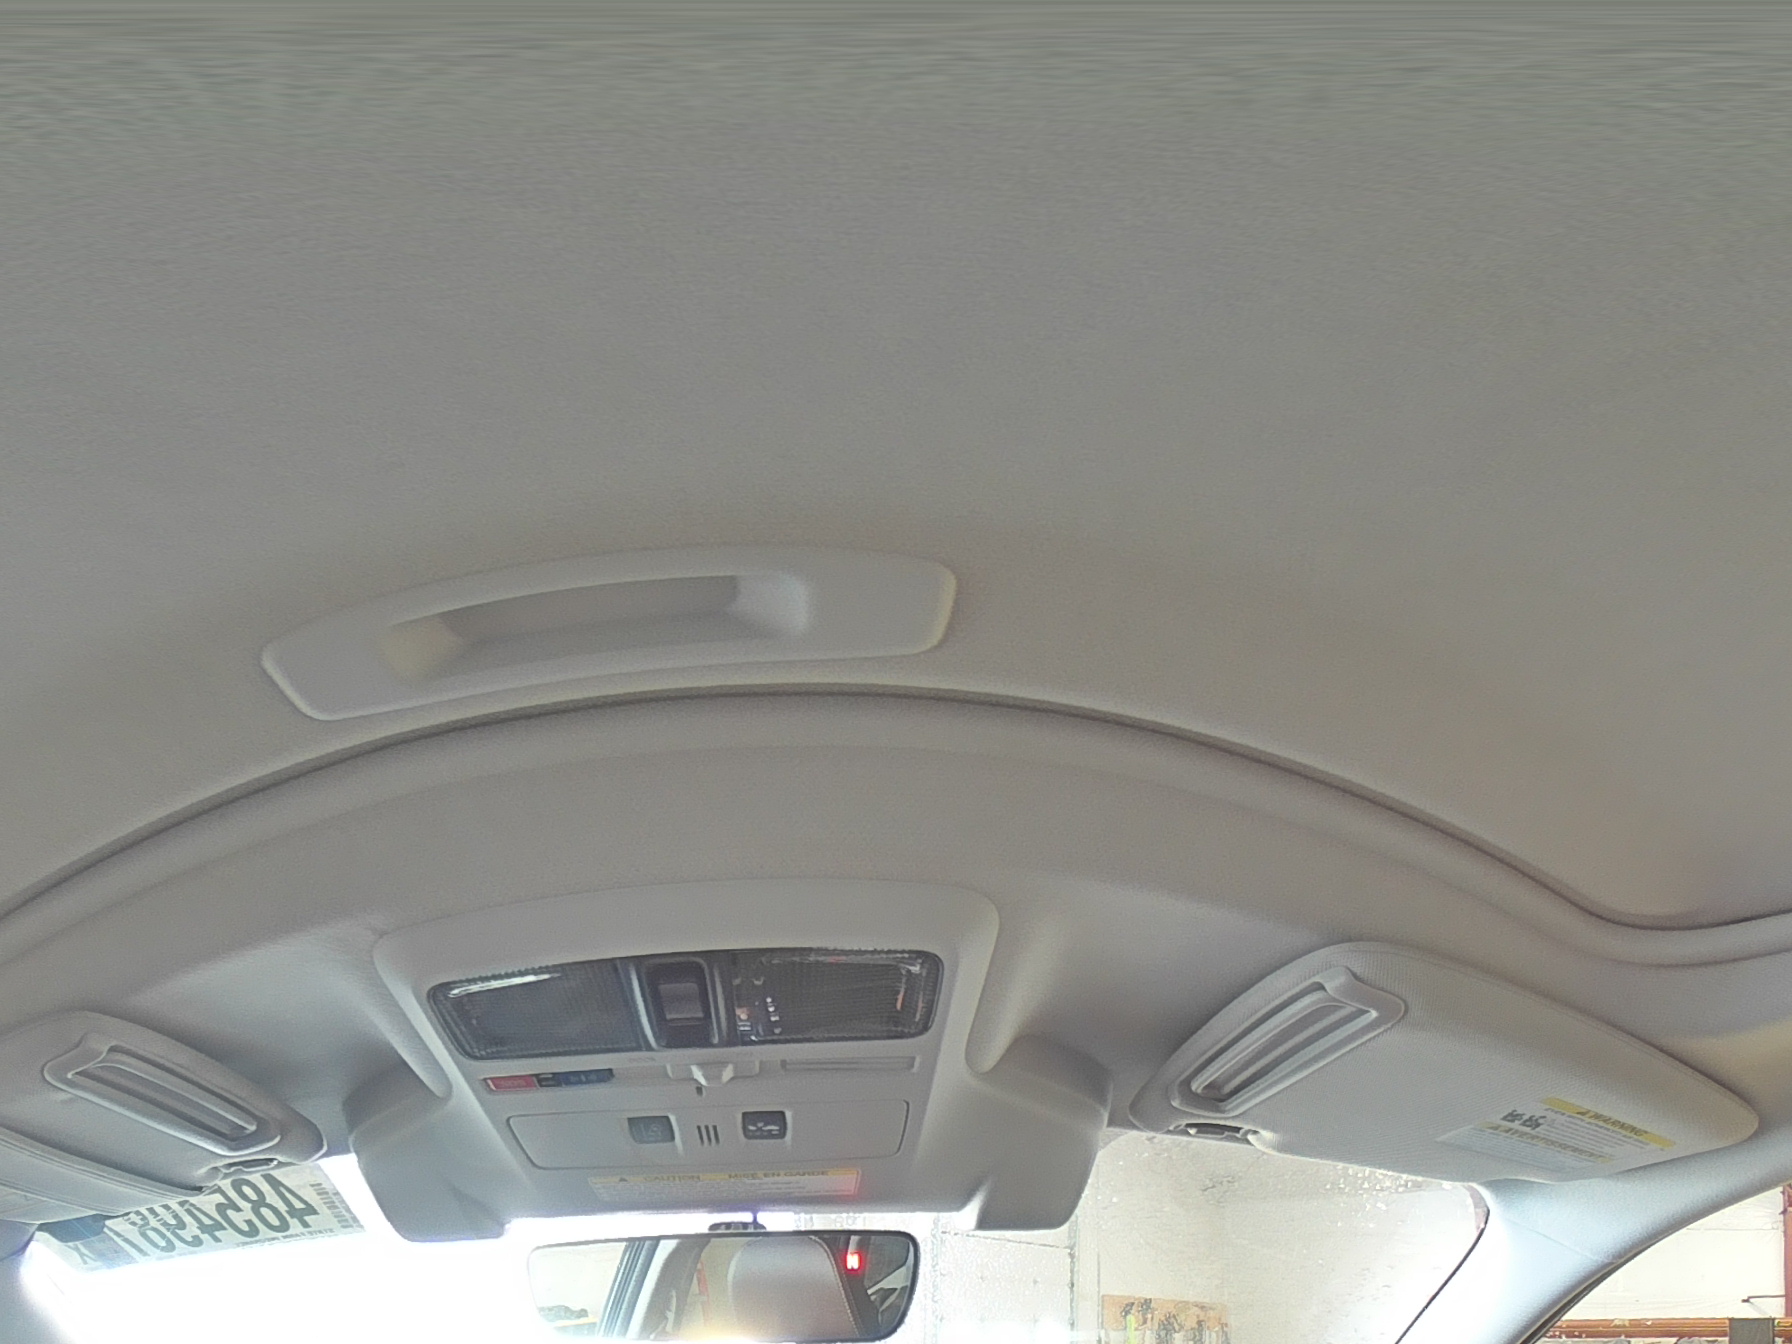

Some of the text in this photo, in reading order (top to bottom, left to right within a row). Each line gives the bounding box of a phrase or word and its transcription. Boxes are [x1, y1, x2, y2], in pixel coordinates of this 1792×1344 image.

[643, 1174, 701, 1183] CAUTION
[763, 1171, 781, 1179] EN
[783, 1170, 830, 1178] GARDE
